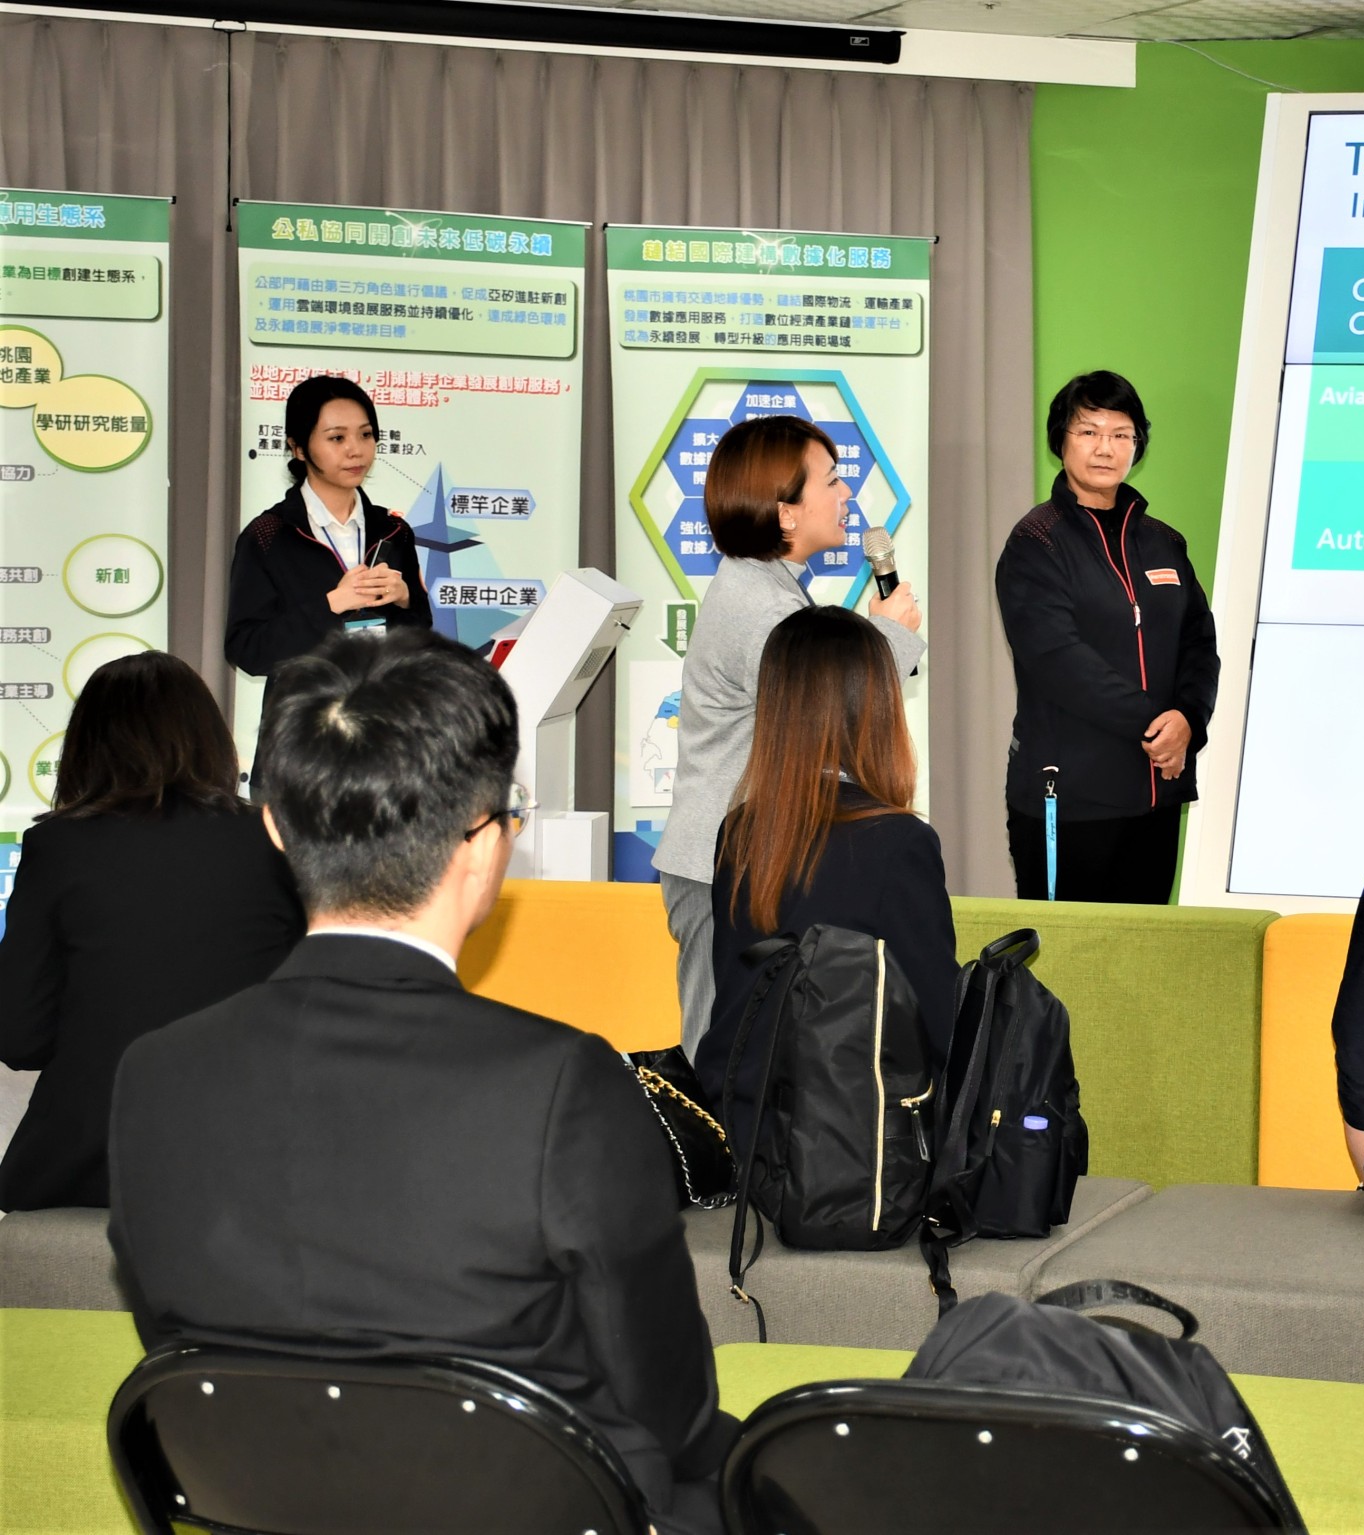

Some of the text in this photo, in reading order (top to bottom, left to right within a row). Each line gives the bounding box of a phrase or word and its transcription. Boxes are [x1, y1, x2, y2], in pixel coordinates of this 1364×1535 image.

[272, 217, 552, 256] 公私協同開創未來低碳永續
[642, 240, 892, 269] 鏈結國際建構數據化服務
[745, 394, 797, 409] 加速企業
[36, 413, 148, 433] 學研研究能量
[258, 424, 286, 437] 訂定
[450, 494, 530, 516] 標竿企業
[680, 521, 713, 536] 強化
[95, 567, 130, 584] 新創
[438, 585, 539, 607] 發展中企業
[0, 628, 48, 643] 務共創
